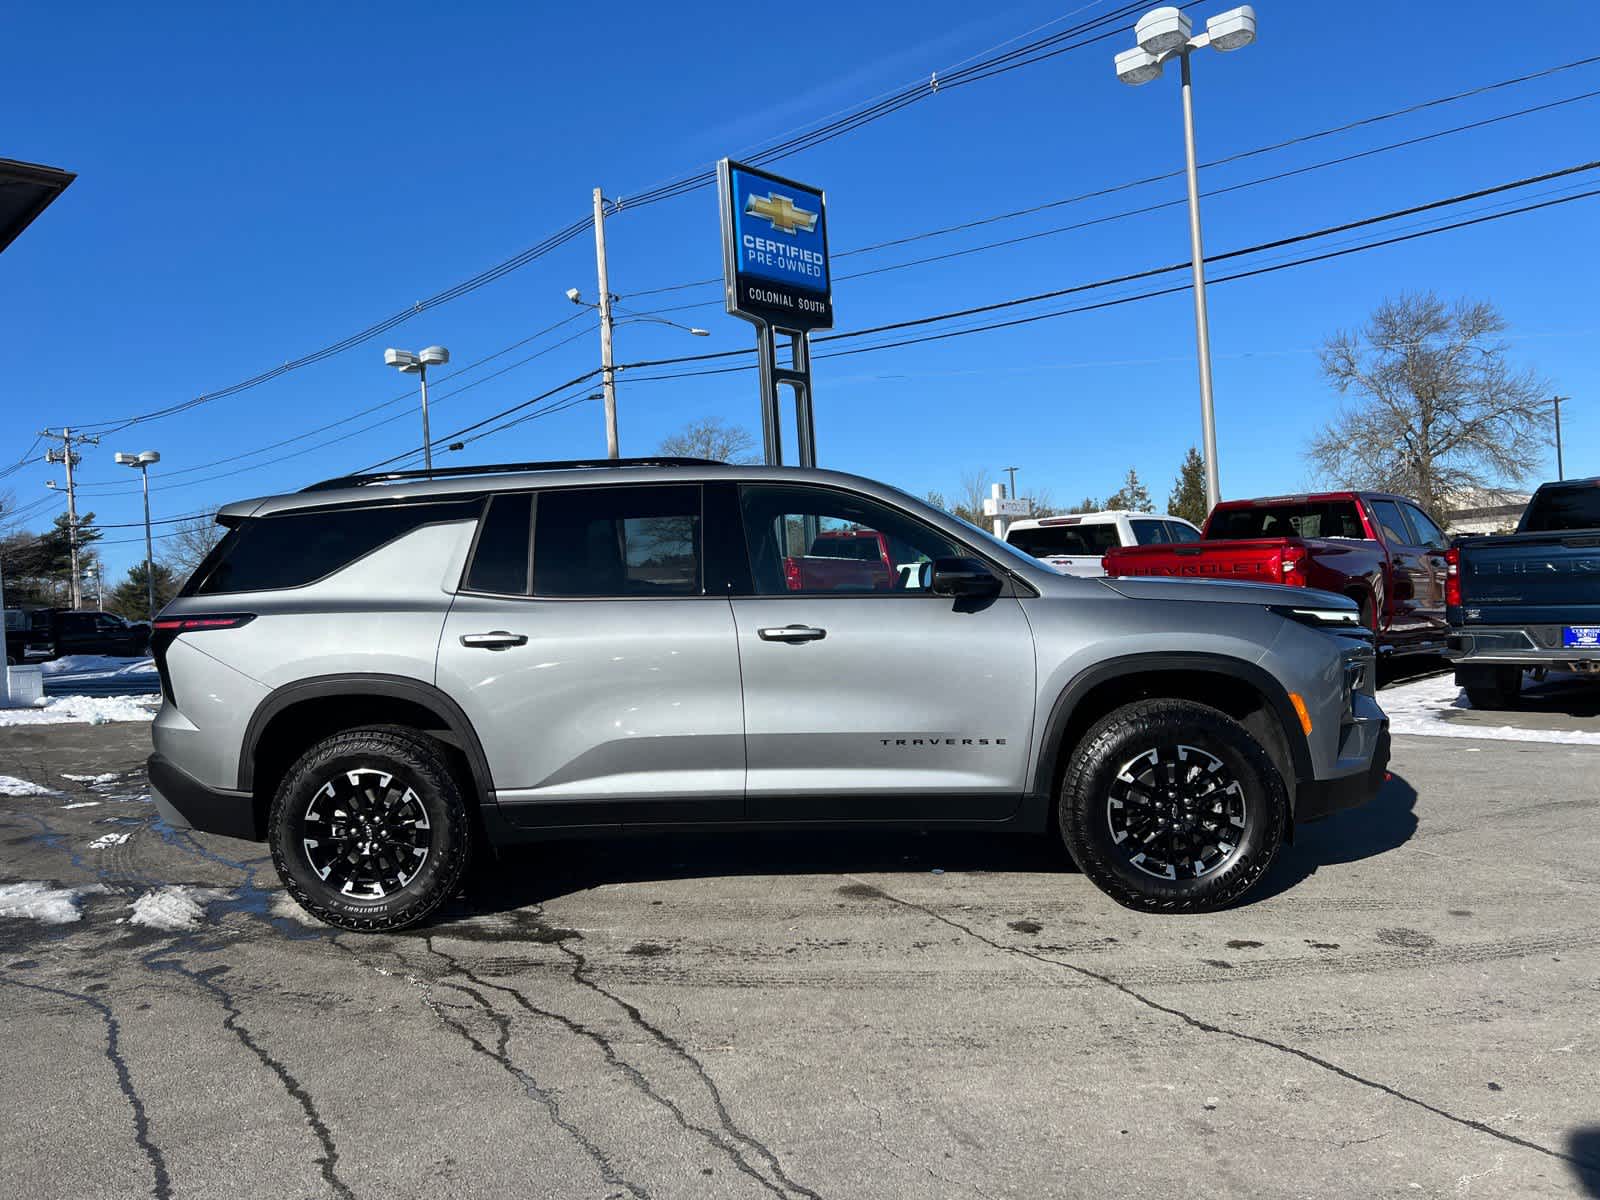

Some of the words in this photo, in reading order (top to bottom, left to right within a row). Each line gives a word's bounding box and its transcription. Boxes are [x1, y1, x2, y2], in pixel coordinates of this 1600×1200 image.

[743, 234, 823, 265] CERTIFIED
[748, 249, 821, 278] PRE-OWNED
[749, 287, 794, 307] COLONIAL
[798, 297, 825, 313] SOUTH
[880, 738, 1008, 746] TRAVERSE
